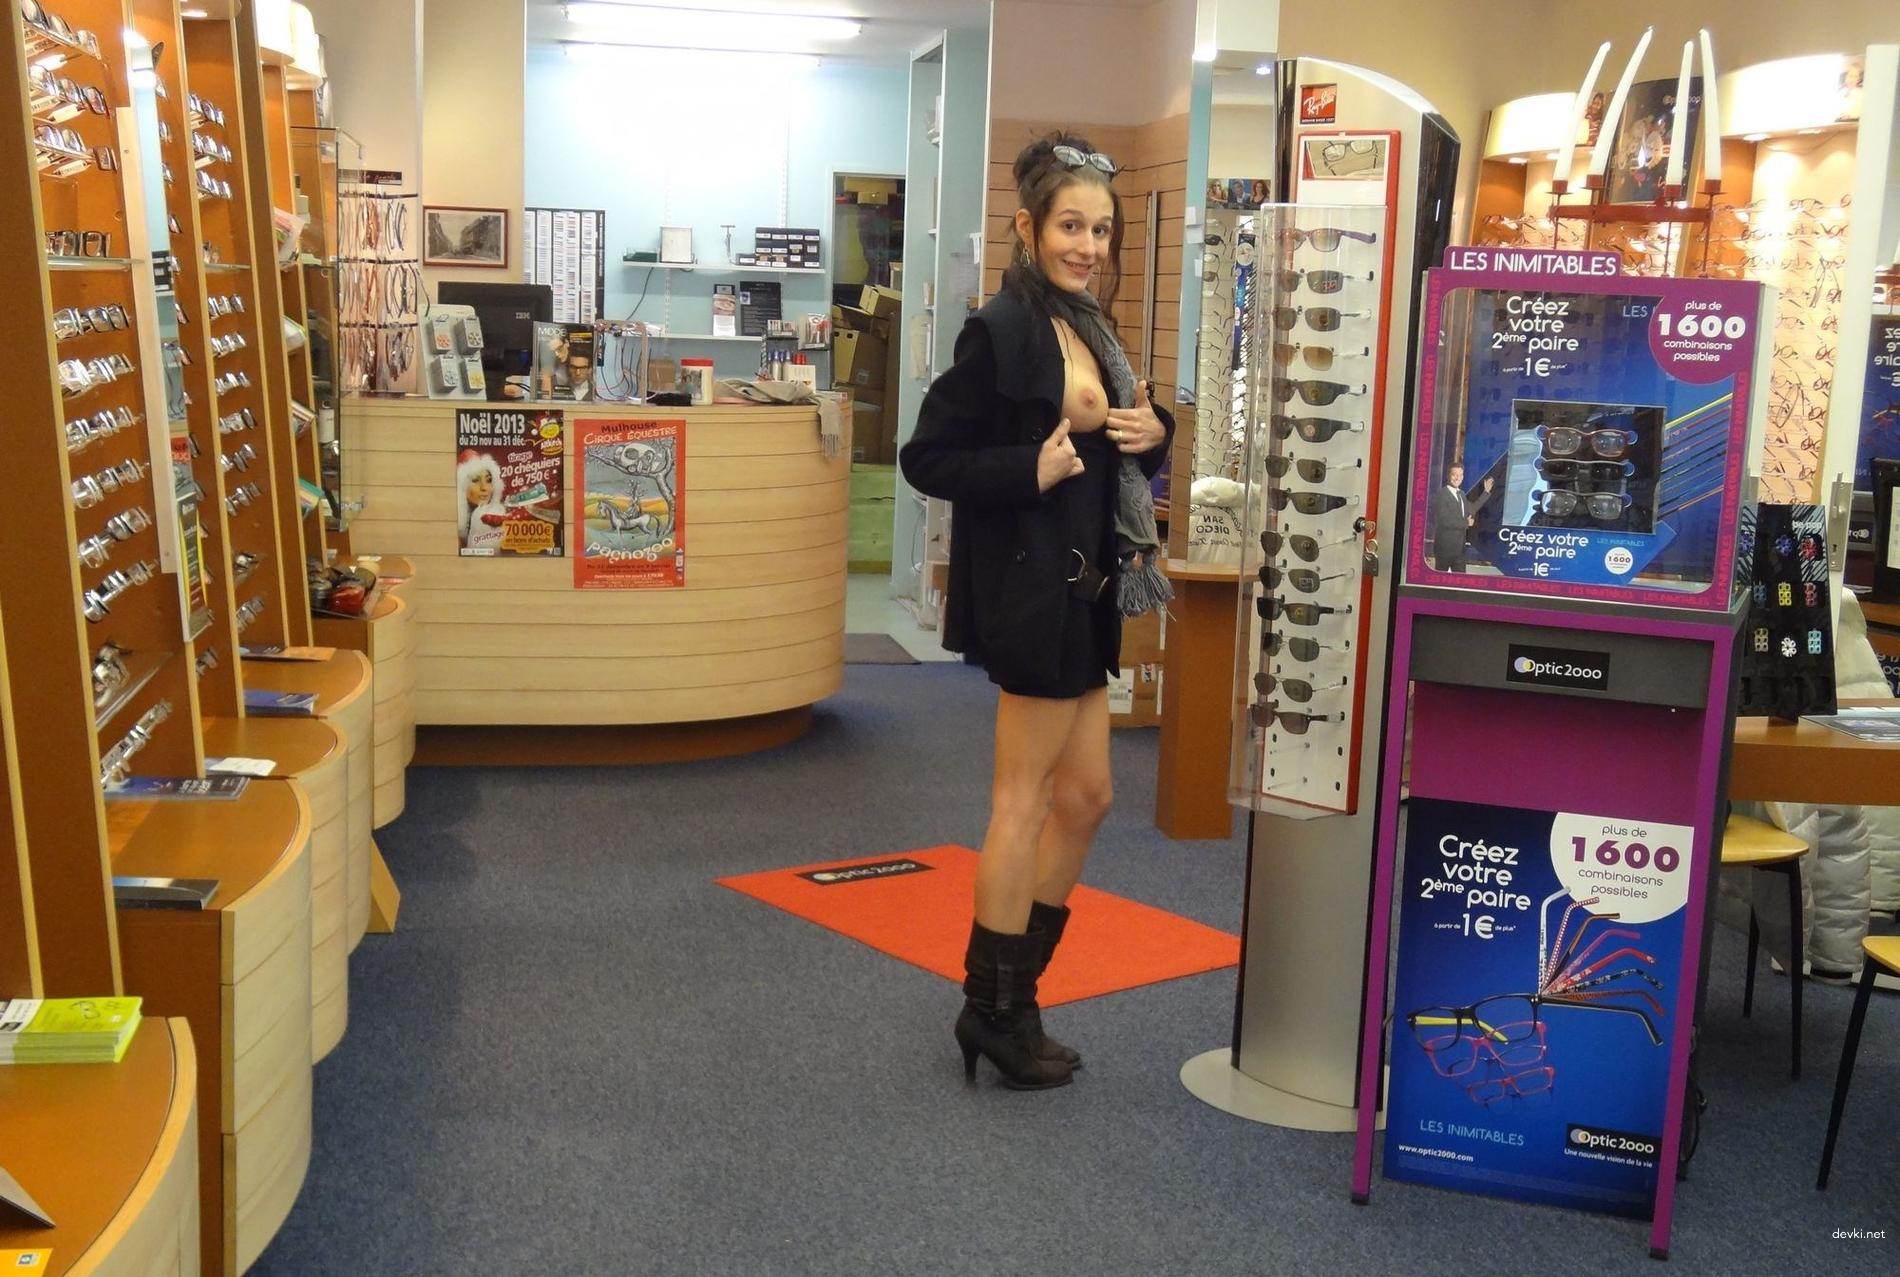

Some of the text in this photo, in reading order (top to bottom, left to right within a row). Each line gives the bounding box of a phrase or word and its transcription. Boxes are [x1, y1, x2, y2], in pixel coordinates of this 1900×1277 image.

[1450, 251, 1616, 276] LES INIMITABLES
[1506, 296, 1570, 316] Créez
[1622, 305, 1648, 318] LES
[1684, 301, 1722, 311] plus de
[1509, 316, 1564, 333] votre
[1658, 313, 1746, 339] 1600
[1492, 333, 1579, 354] 2ème paire
[1663, 339, 1733, 351] combinaisons
[1673, 352, 1720, 362] possibles
[1524, 357, 1551, 377] 1€
[459, 412, 525, 434] Noël 2013
[601, 422, 657, 434] Mulhouse
[459, 435, 469, 446] du
[469, 435, 479, 446] 29
[479, 437, 492, 446] nov
[493, 437, 502, 446] au
[503, 435, 511, 446] 31
[501, 466, 513, 478] 20
[511, 470, 550, 487] de 750 €
[505, 523, 519, 536] 70
[1499, 528, 1589, 547] Créez votre
[1508, 542, 1576, 559] 2ème paire
[1533, 563, 1550, 576] 1€
[1523, 659, 1602, 680] Optic 2000
[1602, 824, 1647, 838] plus de
[1438, 834, 1519, 865] Créez
[1571, 836, 1680, 872] 1600
[1442, 861, 1513, 886] votre
[1578, 867, 1664, 887] combinaisons
[1420, 878, 1531, 911] 2ème paire
[1591, 883, 1648, 900] possibles
[1462, 913, 1495, 939] 1€
[1420, 1119, 1525, 1146] LES INIMITABLES
[1578, 1131, 1655, 1154] Optic 2000
[1398, 1144, 1474, 1162] www.optic2000.com
[1564, 1148, 1577, 1156] Une
[1578, 1150, 1606, 1161] nouvelle
[1606, 1155, 1626, 1164] vision
[1626, 1157, 1635, 1165] de
[1635, 1159, 1642, 1167] la
